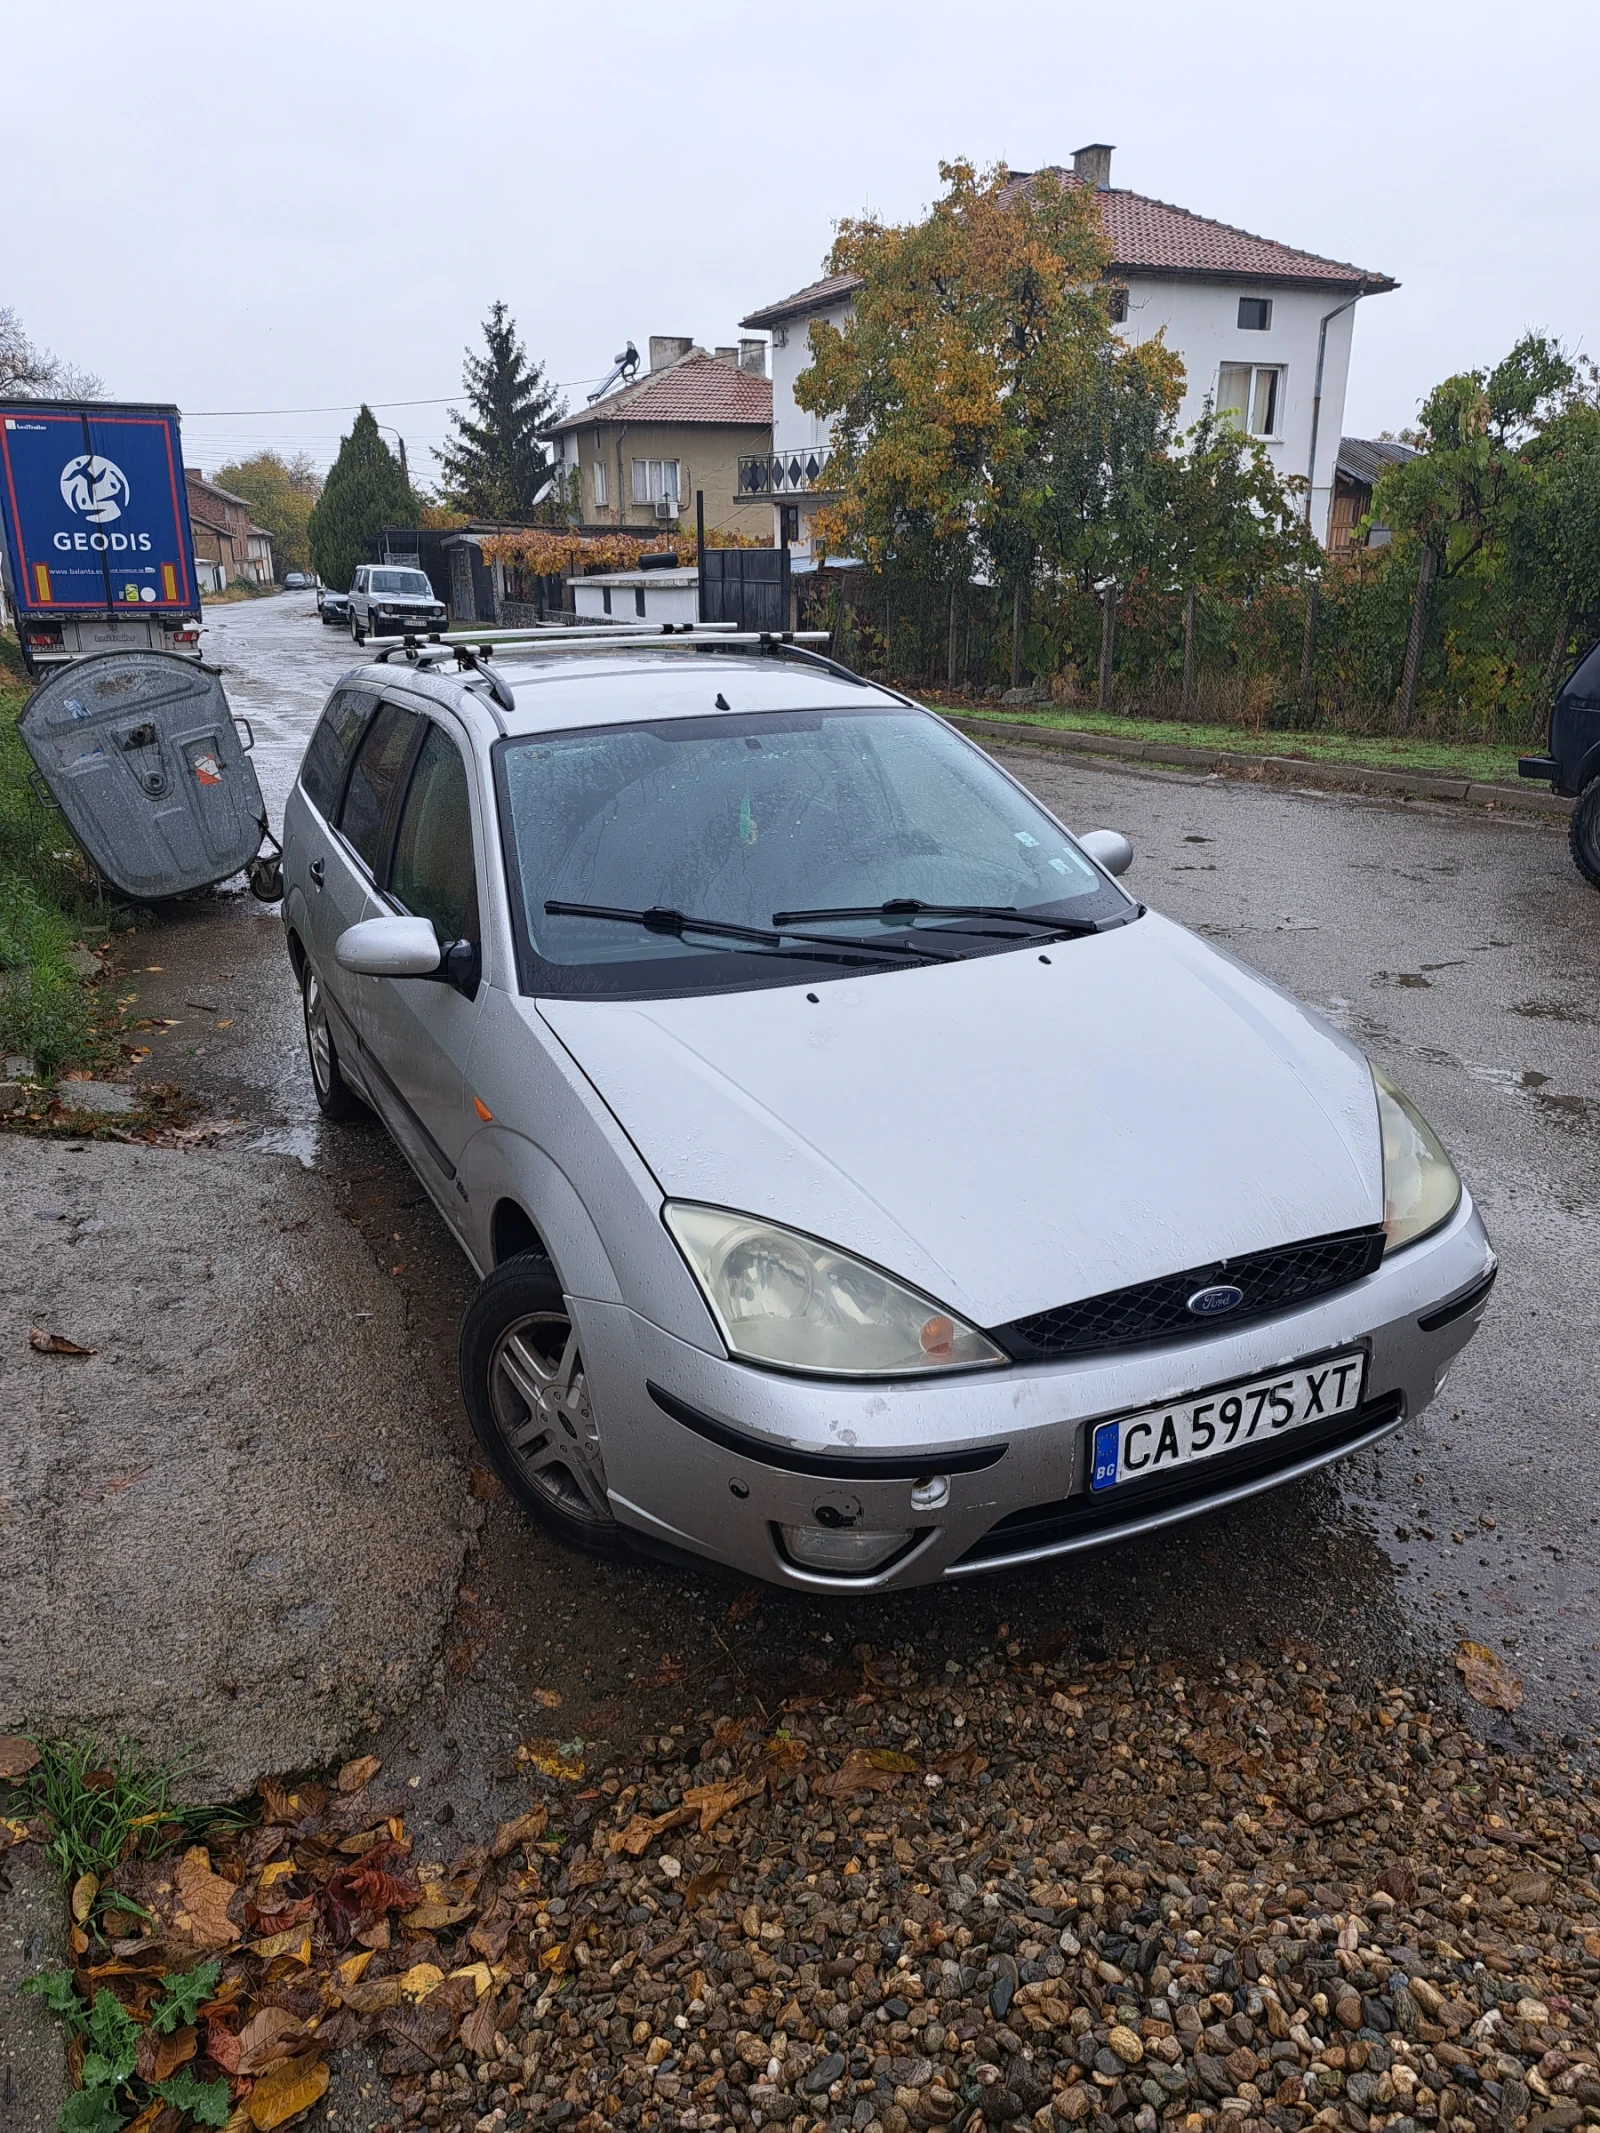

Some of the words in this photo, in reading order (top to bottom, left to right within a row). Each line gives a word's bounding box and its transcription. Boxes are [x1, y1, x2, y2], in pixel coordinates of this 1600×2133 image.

[53, 531, 152, 551] GEODIS
[1202, 1292, 1231, 1310] Ford
[1123, 1415, 1179, 1471] CA
[1191, 1382, 1294, 1452] 5975
[1303, 1363, 1357, 1419] XT
[1096, 1463, 1115, 1480] BG
